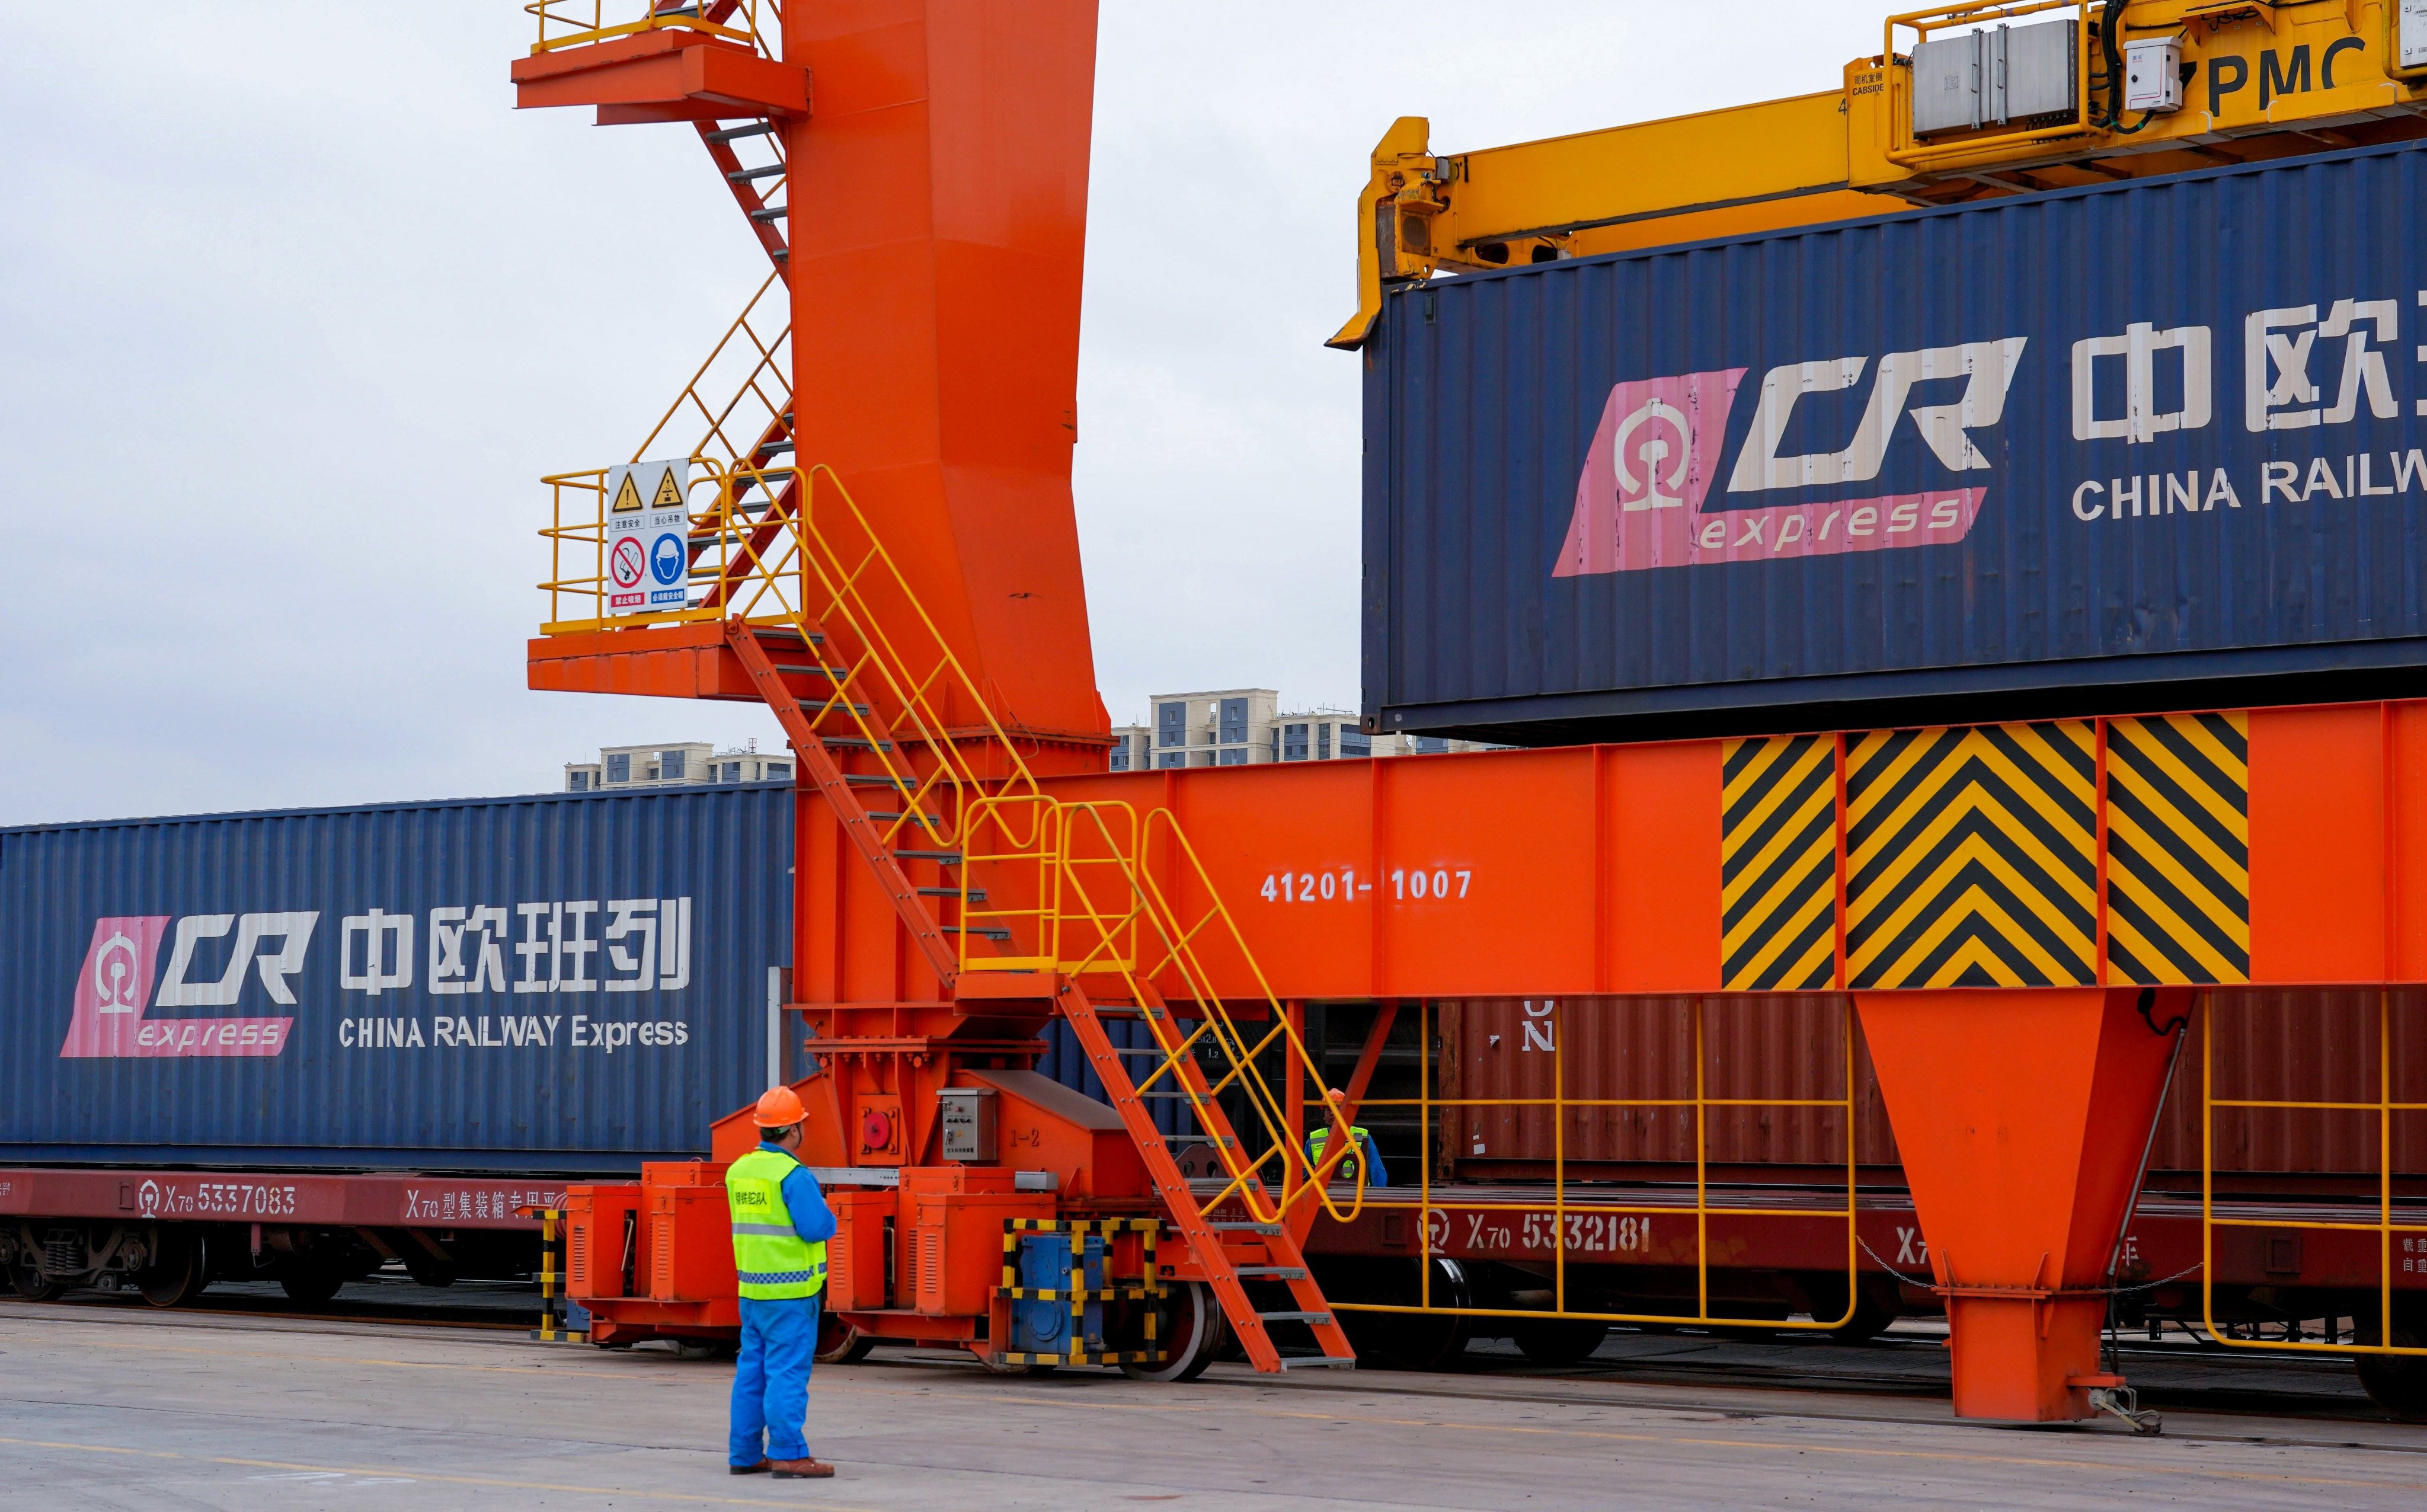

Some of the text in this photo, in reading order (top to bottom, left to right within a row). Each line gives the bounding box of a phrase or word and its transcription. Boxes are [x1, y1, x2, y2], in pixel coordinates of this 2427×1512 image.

[1853, 84, 1884, 95] CABSIDE
[1854, 73, 1882, 85] 司机室侧
[2072, 289, 2427, 445] 中欧
[1727, 337, 2028, 493] CR
[2072, 467, 2241, 522] CHINA
[615, 519, 641, 529] 注意安全
[654, 514, 681, 525] 当心吊物
[1700, 498, 1960, 552] express
[155, 911, 320, 1007] CR
[341, 897, 692, 996] 中欧班列
[138, 1022, 280, 1052] express
[340, 1015, 689, 1054] CHINA RAILWAY Express
[1011, 1129, 1040, 1147] 1-2
[164, 1184, 295, 1214] X70 5337083
[1467, 1213, 1649, 1252] X70 5332181
[2403, 1238, 2427, 1252] 载重
[2403, 1257, 2427, 1273] 自重
